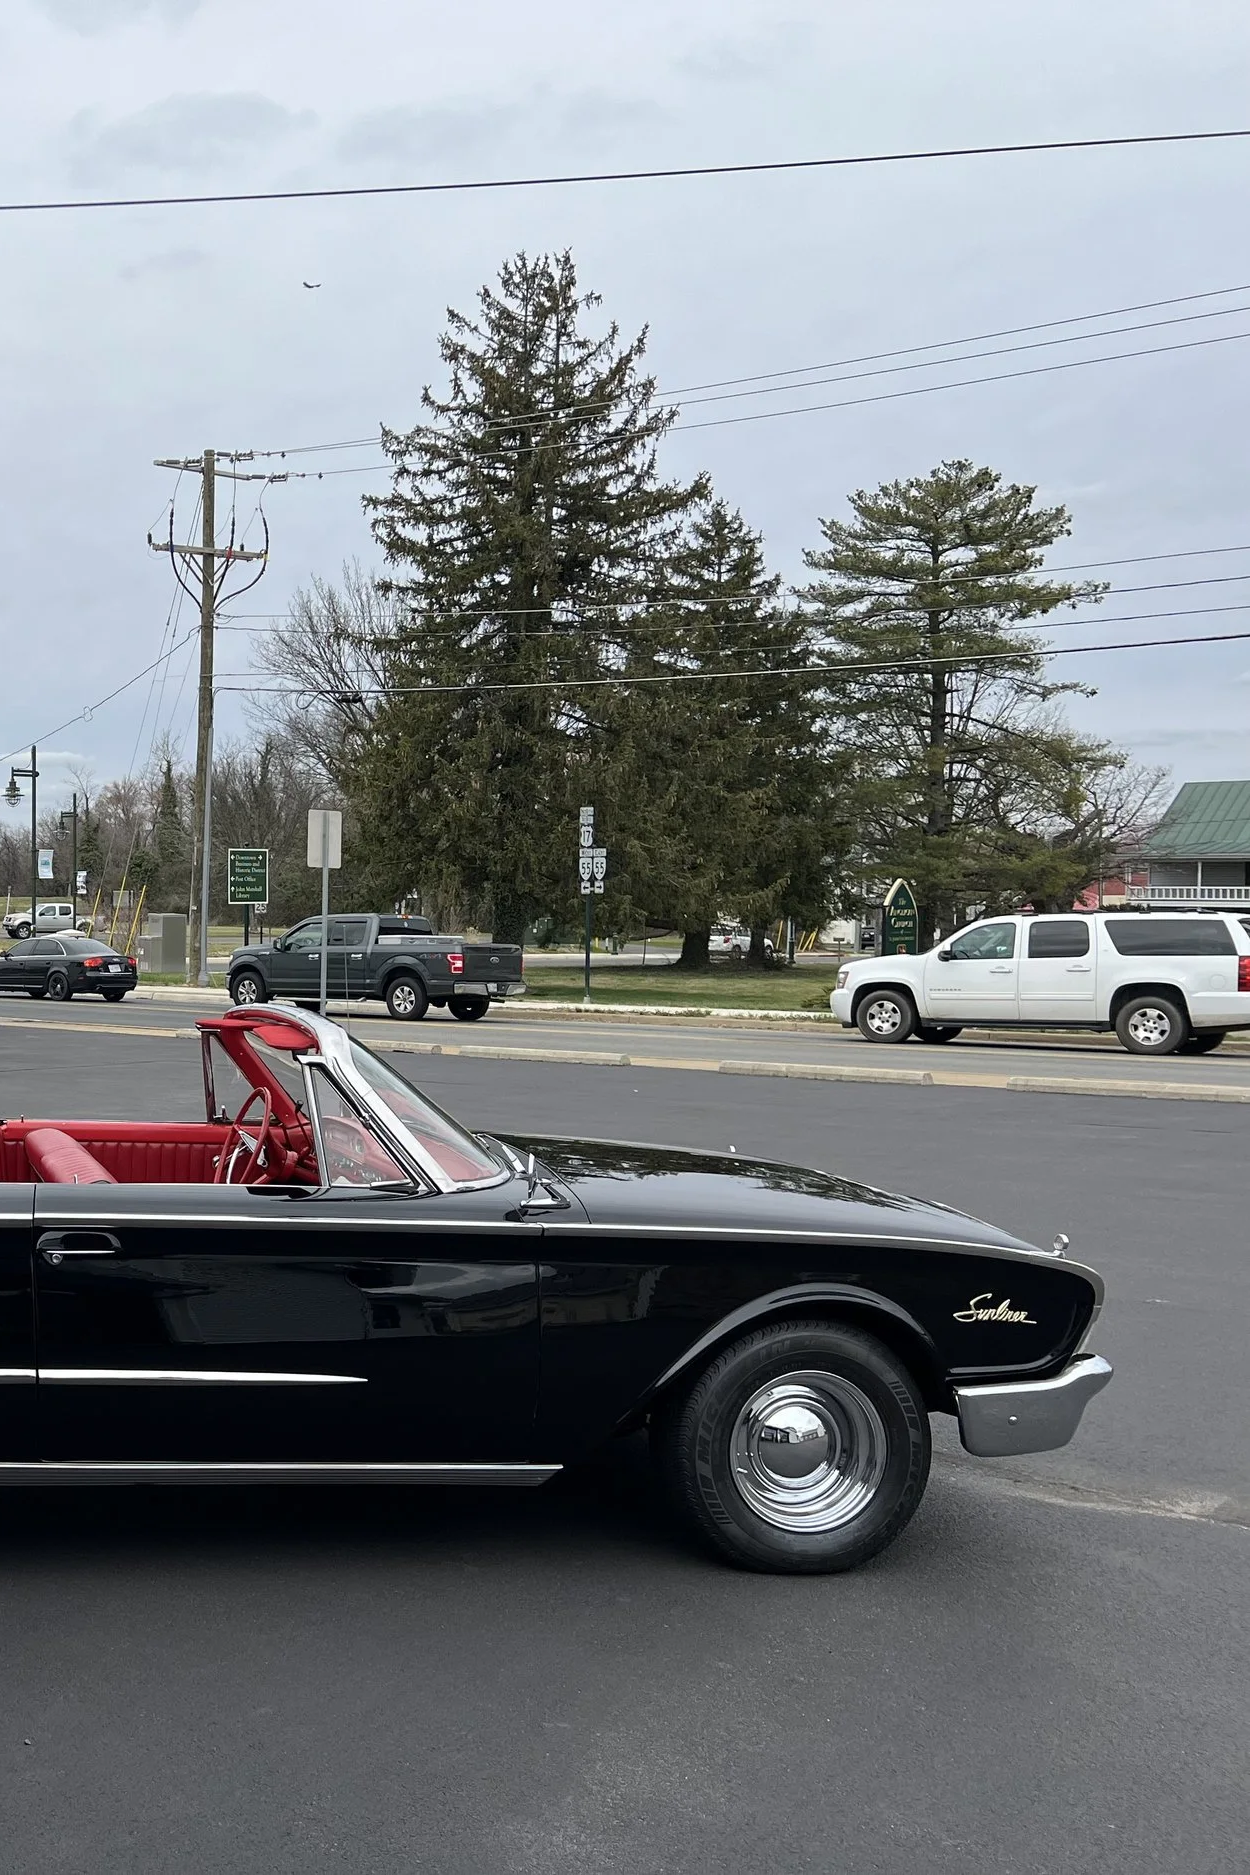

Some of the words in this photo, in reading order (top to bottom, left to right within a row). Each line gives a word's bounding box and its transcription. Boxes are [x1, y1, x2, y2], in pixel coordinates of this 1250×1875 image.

[583, 831, 591, 843] 17
[582, 863, 591, 875] 55
[595, 862, 605, 874] 55
[255, 904, 267, 912] 25
[953, 1293, 1037, 1324] Sunliner
